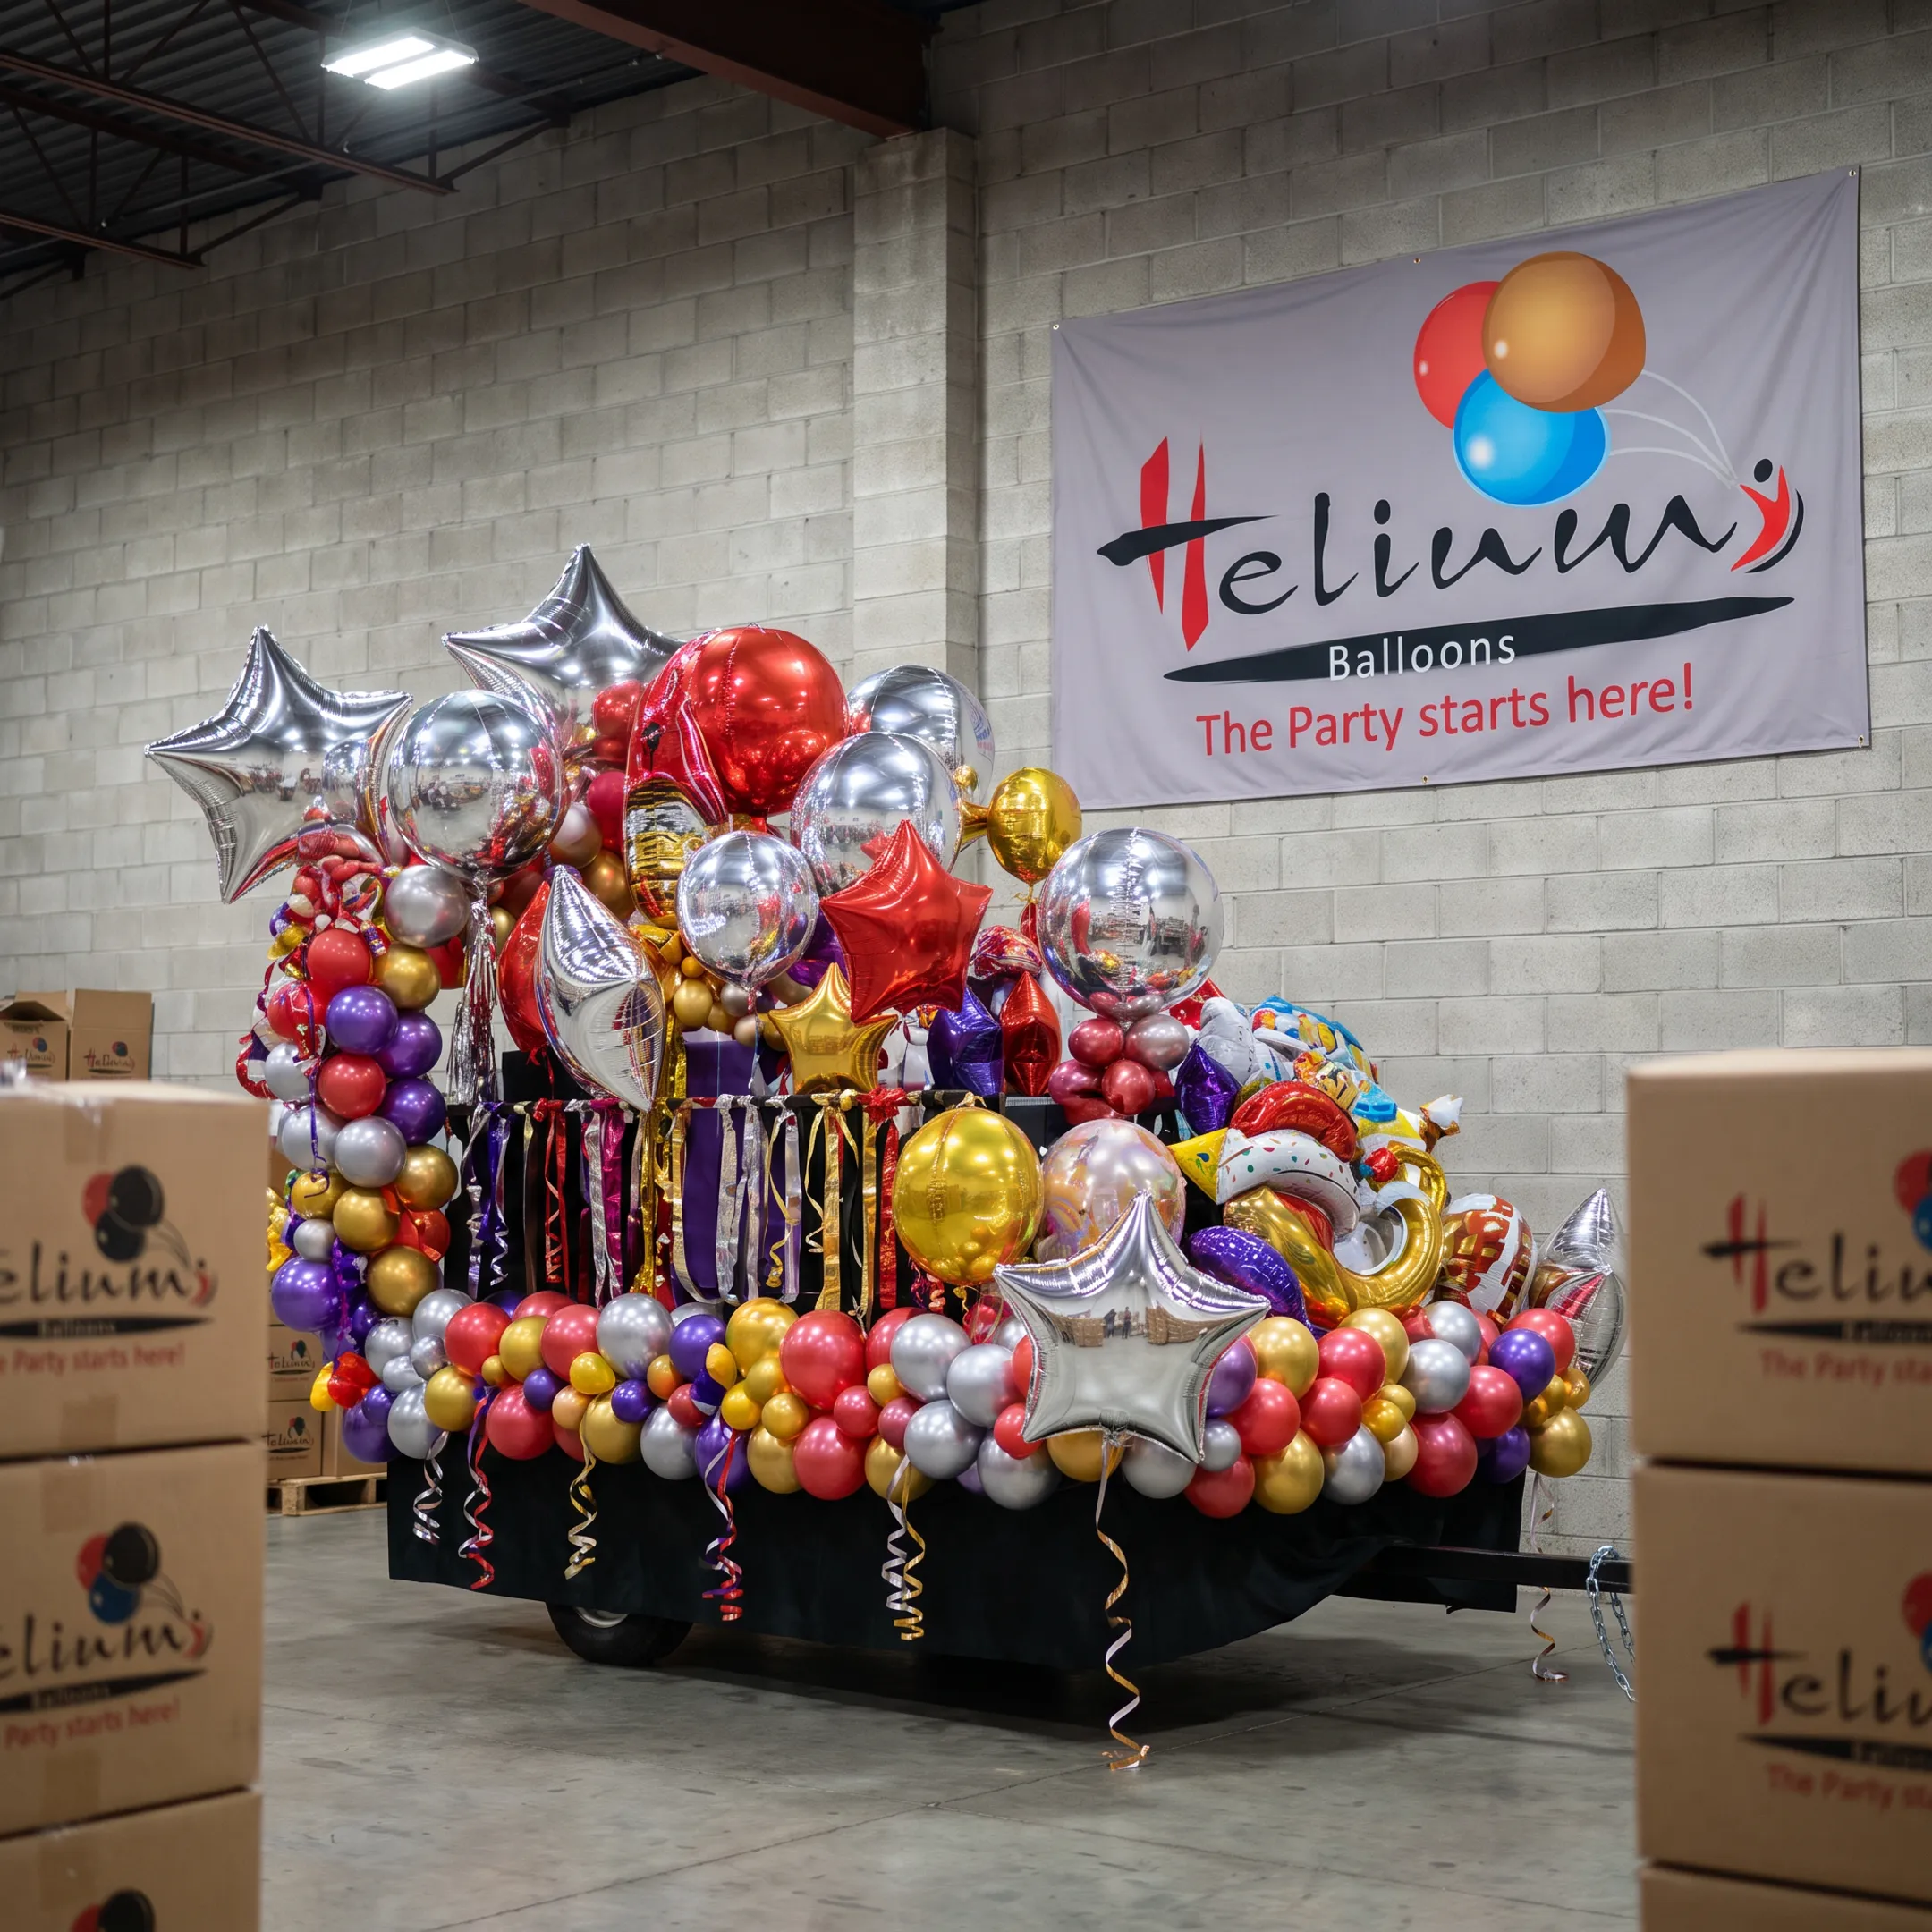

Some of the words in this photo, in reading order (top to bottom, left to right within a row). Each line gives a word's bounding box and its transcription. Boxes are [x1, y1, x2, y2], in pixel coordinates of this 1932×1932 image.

[1097, 433, 1739, 651] Helium
[1329, 634, 1516, 682] Balloons
[1195, 710, 1273, 757] The
[1289, 703, 1404, 752] Party
[1419, 688, 1550, 737] starts
[1567, 662, 1693, 723] here!
[0, 1238, 191, 1305] elium
[1701, 1191, 1932, 1315] Heliu
